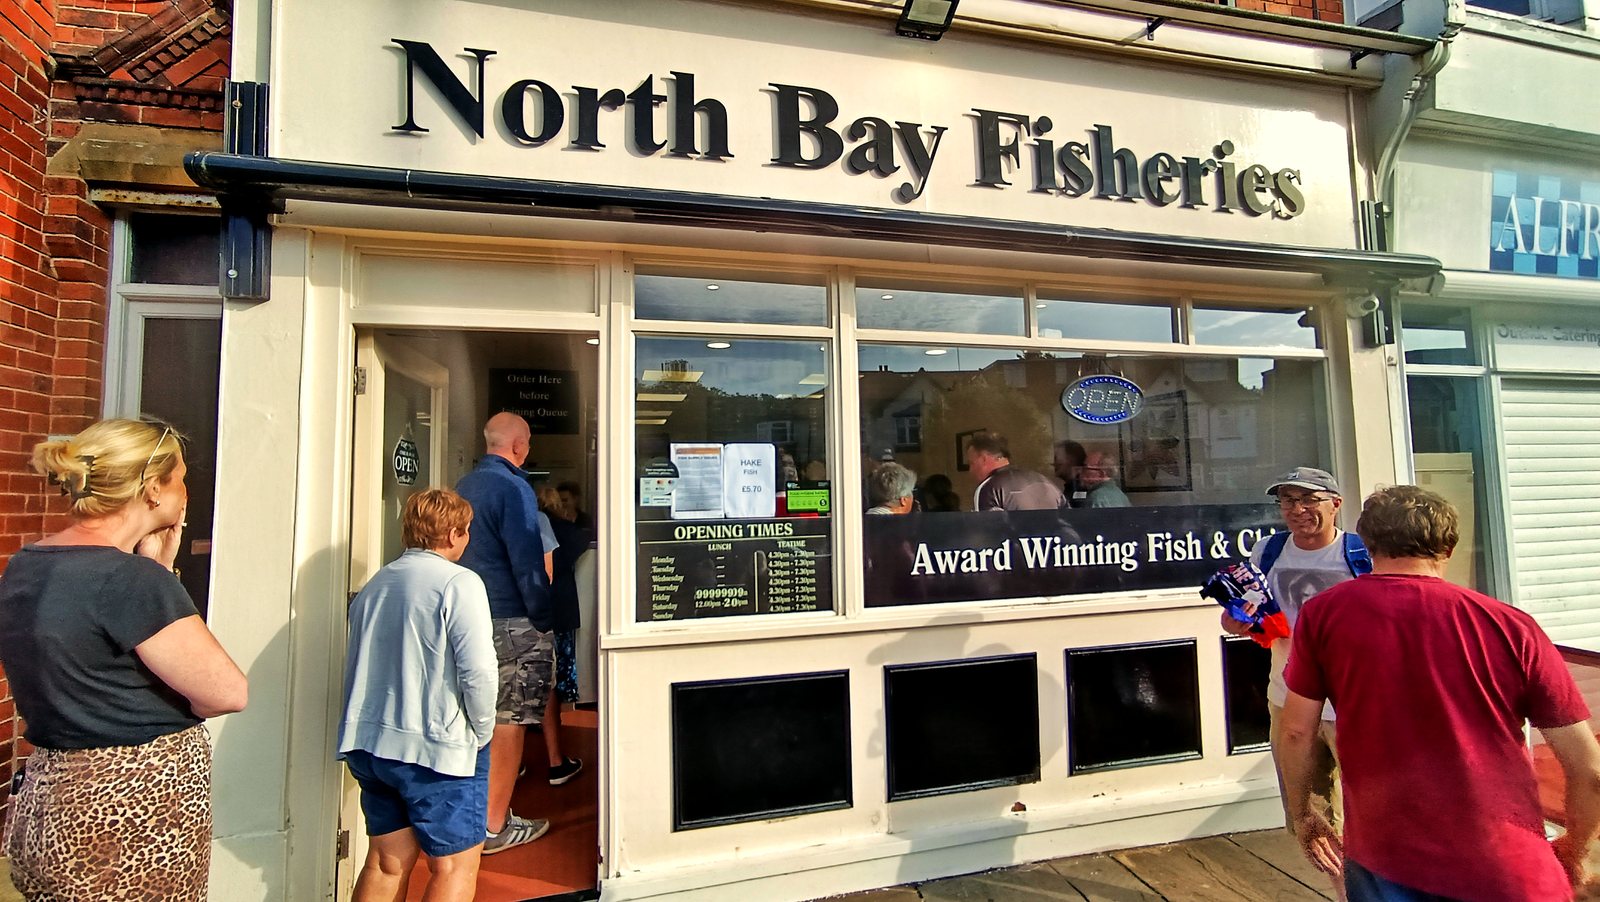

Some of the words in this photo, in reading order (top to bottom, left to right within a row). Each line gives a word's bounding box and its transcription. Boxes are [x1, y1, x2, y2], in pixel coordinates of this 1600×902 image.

[390, 38, 735, 162] North
[768, 82, 948, 201] Bay
[970, 107, 1306, 218] Fisheries
[1494, 192, 1600, 260] ALFR
[507, 374, 536, 383] Order
[539, 375, 562, 384] Here
[520, 391, 550, 400] before
[1068, 388, 1140, 414] OPEN
[537, 408, 568, 417] Queue
[395, 455, 418, 472] OPEN
[674, 524, 743, 540] OPENING
[747, 522, 793, 538] TIMES
[910, 539, 1012, 576] Award
[1018, 533, 1138, 571] Winning
[1146, 530, 1202, 562] Fish
[1210, 531, 1230, 558] &
[652, 594, 670, 602] Friday
